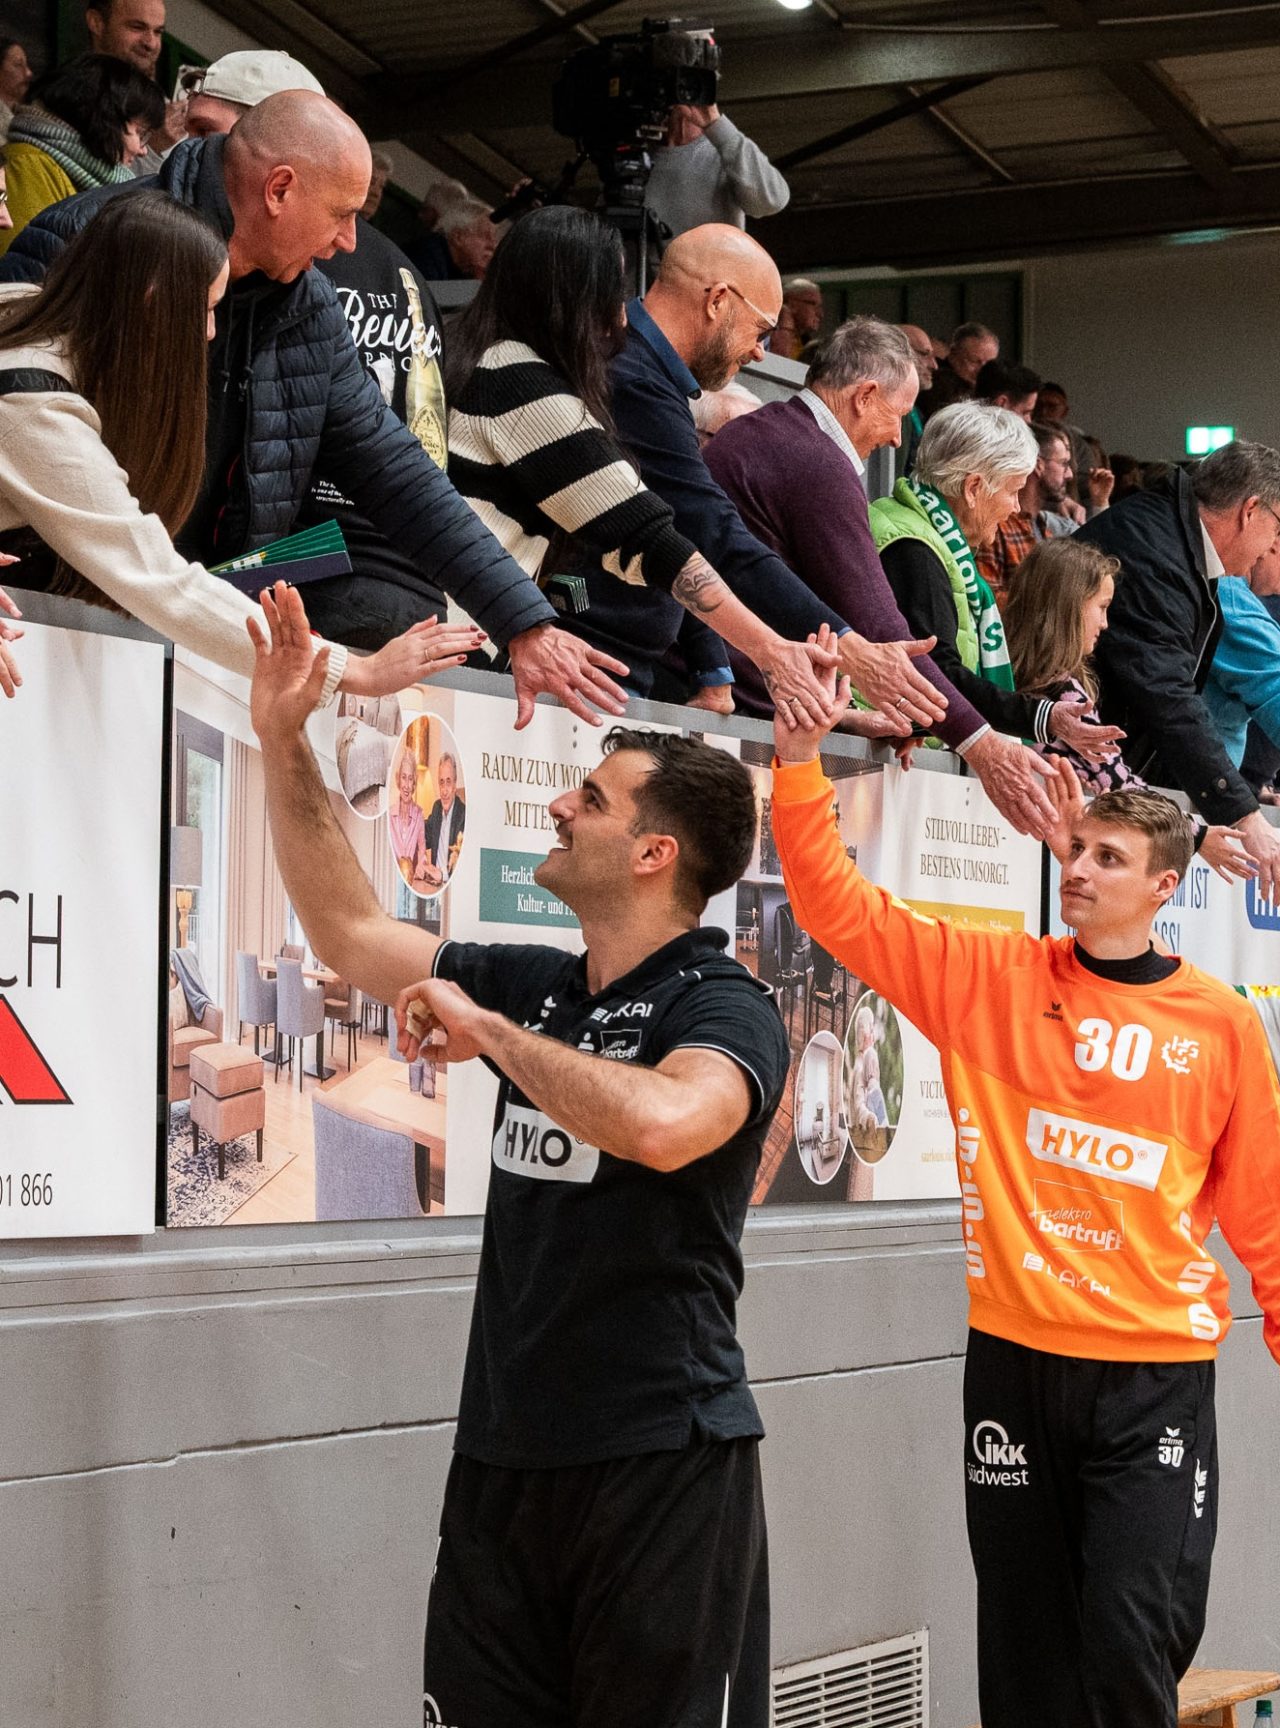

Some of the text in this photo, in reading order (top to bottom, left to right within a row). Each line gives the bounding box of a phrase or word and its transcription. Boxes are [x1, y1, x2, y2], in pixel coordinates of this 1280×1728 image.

[481, 752, 596, 791] RAUM ZUM WO
[504, 800, 556, 831] MITTE
[925, 817, 968, 844] STILVOLL
[971, 823, 1000, 848] LEBEN
[920, 853, 962, 880] BESTENS
[1190, 866, 1210, 910] IST
[1074, 1017, 1153, 1082] 30
[504, 1118, 572, 1168] HYLO
[1041, 1122, 1135, 1173] HYLO
[20, 1172, 54, 1207] 866
[1038, 1214, 1124, 1252] bartruff
[1158, 1445, 1185, 1468] 30
